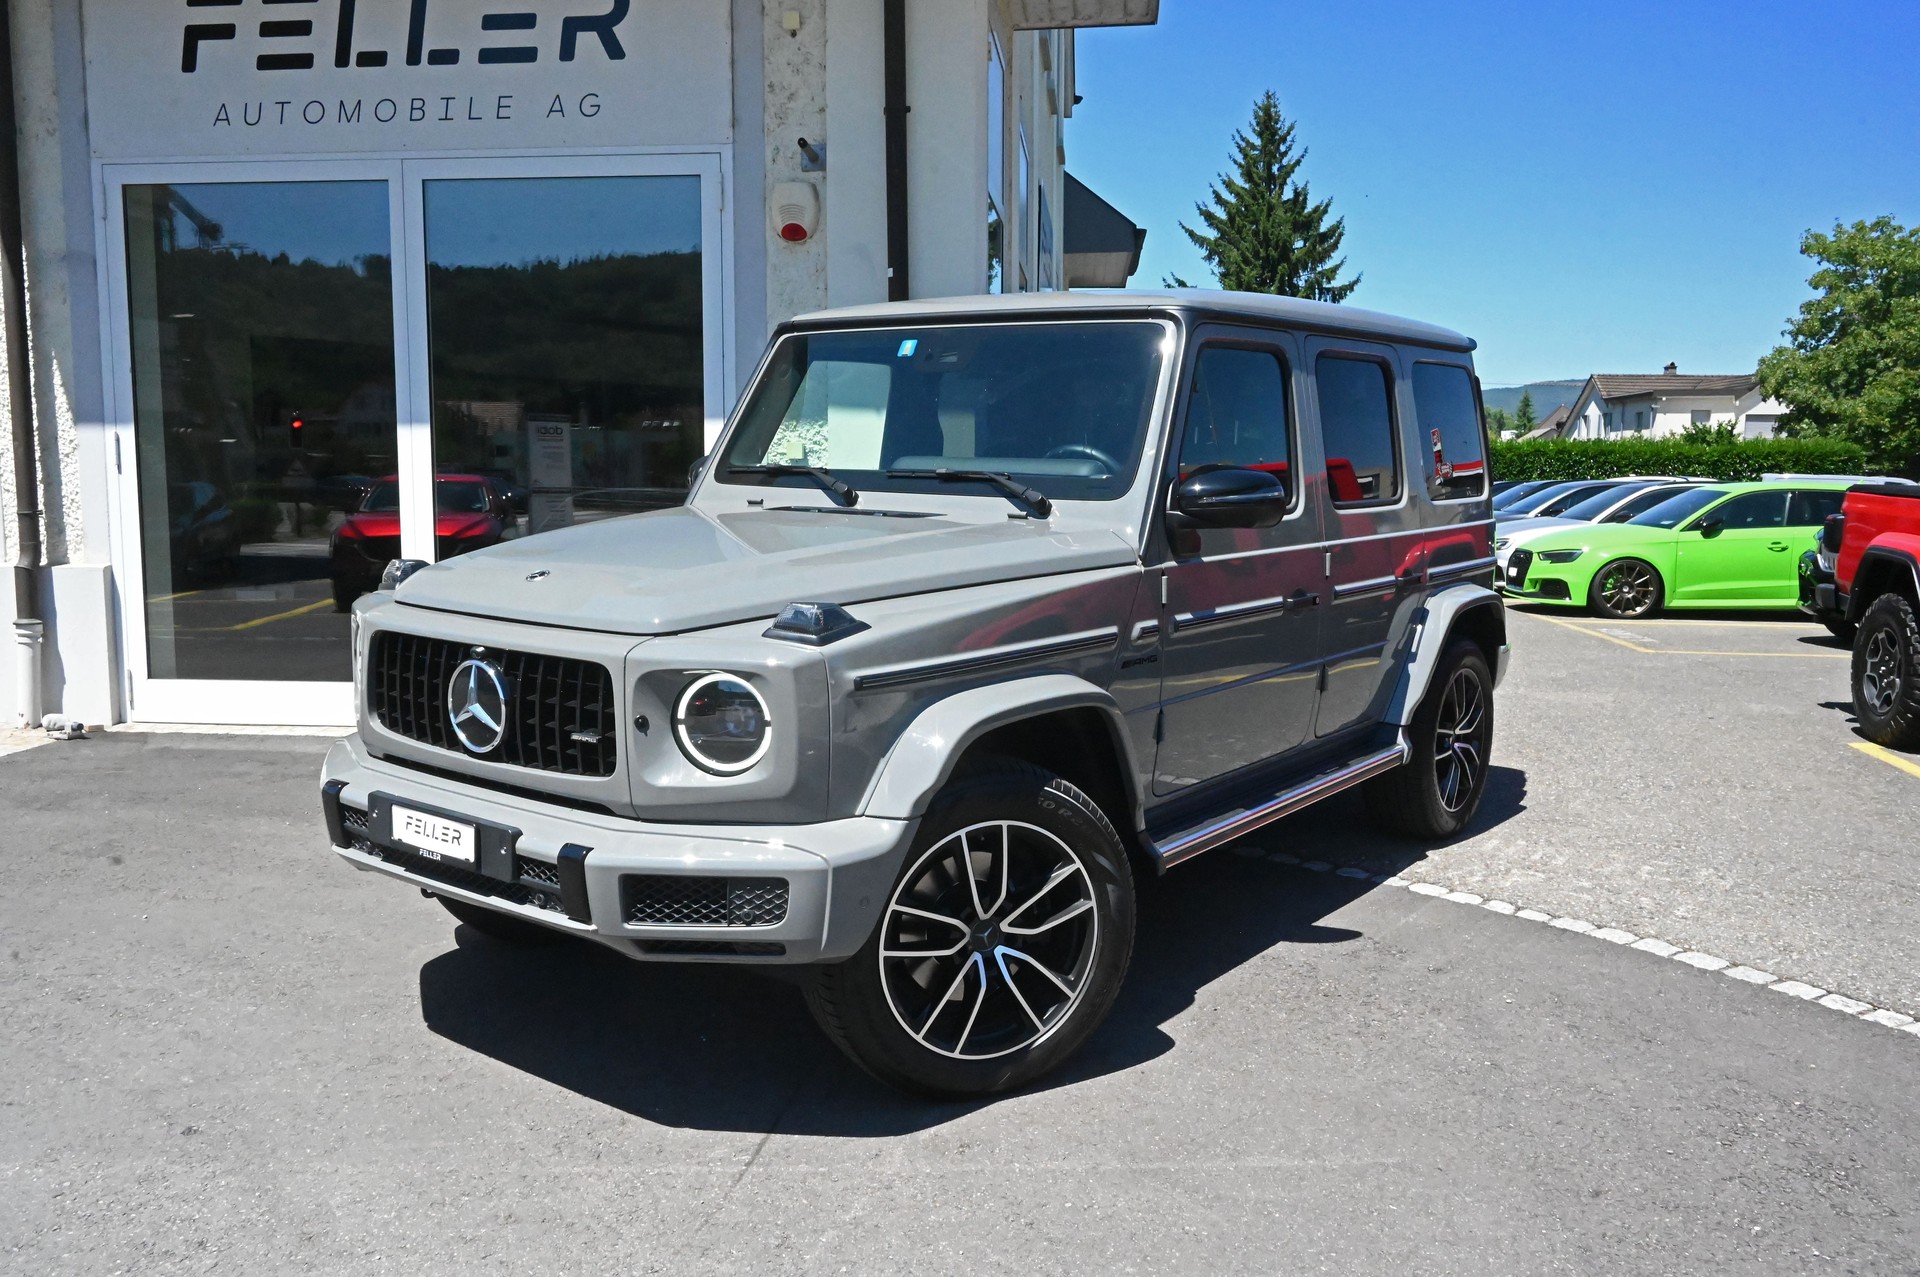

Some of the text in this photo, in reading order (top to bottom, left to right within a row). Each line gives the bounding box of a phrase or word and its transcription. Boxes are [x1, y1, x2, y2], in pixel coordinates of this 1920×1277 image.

[181, 0, 629, 73] FELLER
[213, 93, 602, 127] AUTOMOBILE AG
[406, 815, 462, 846] FELLER
[419, 848, 442, 861] FELLER
